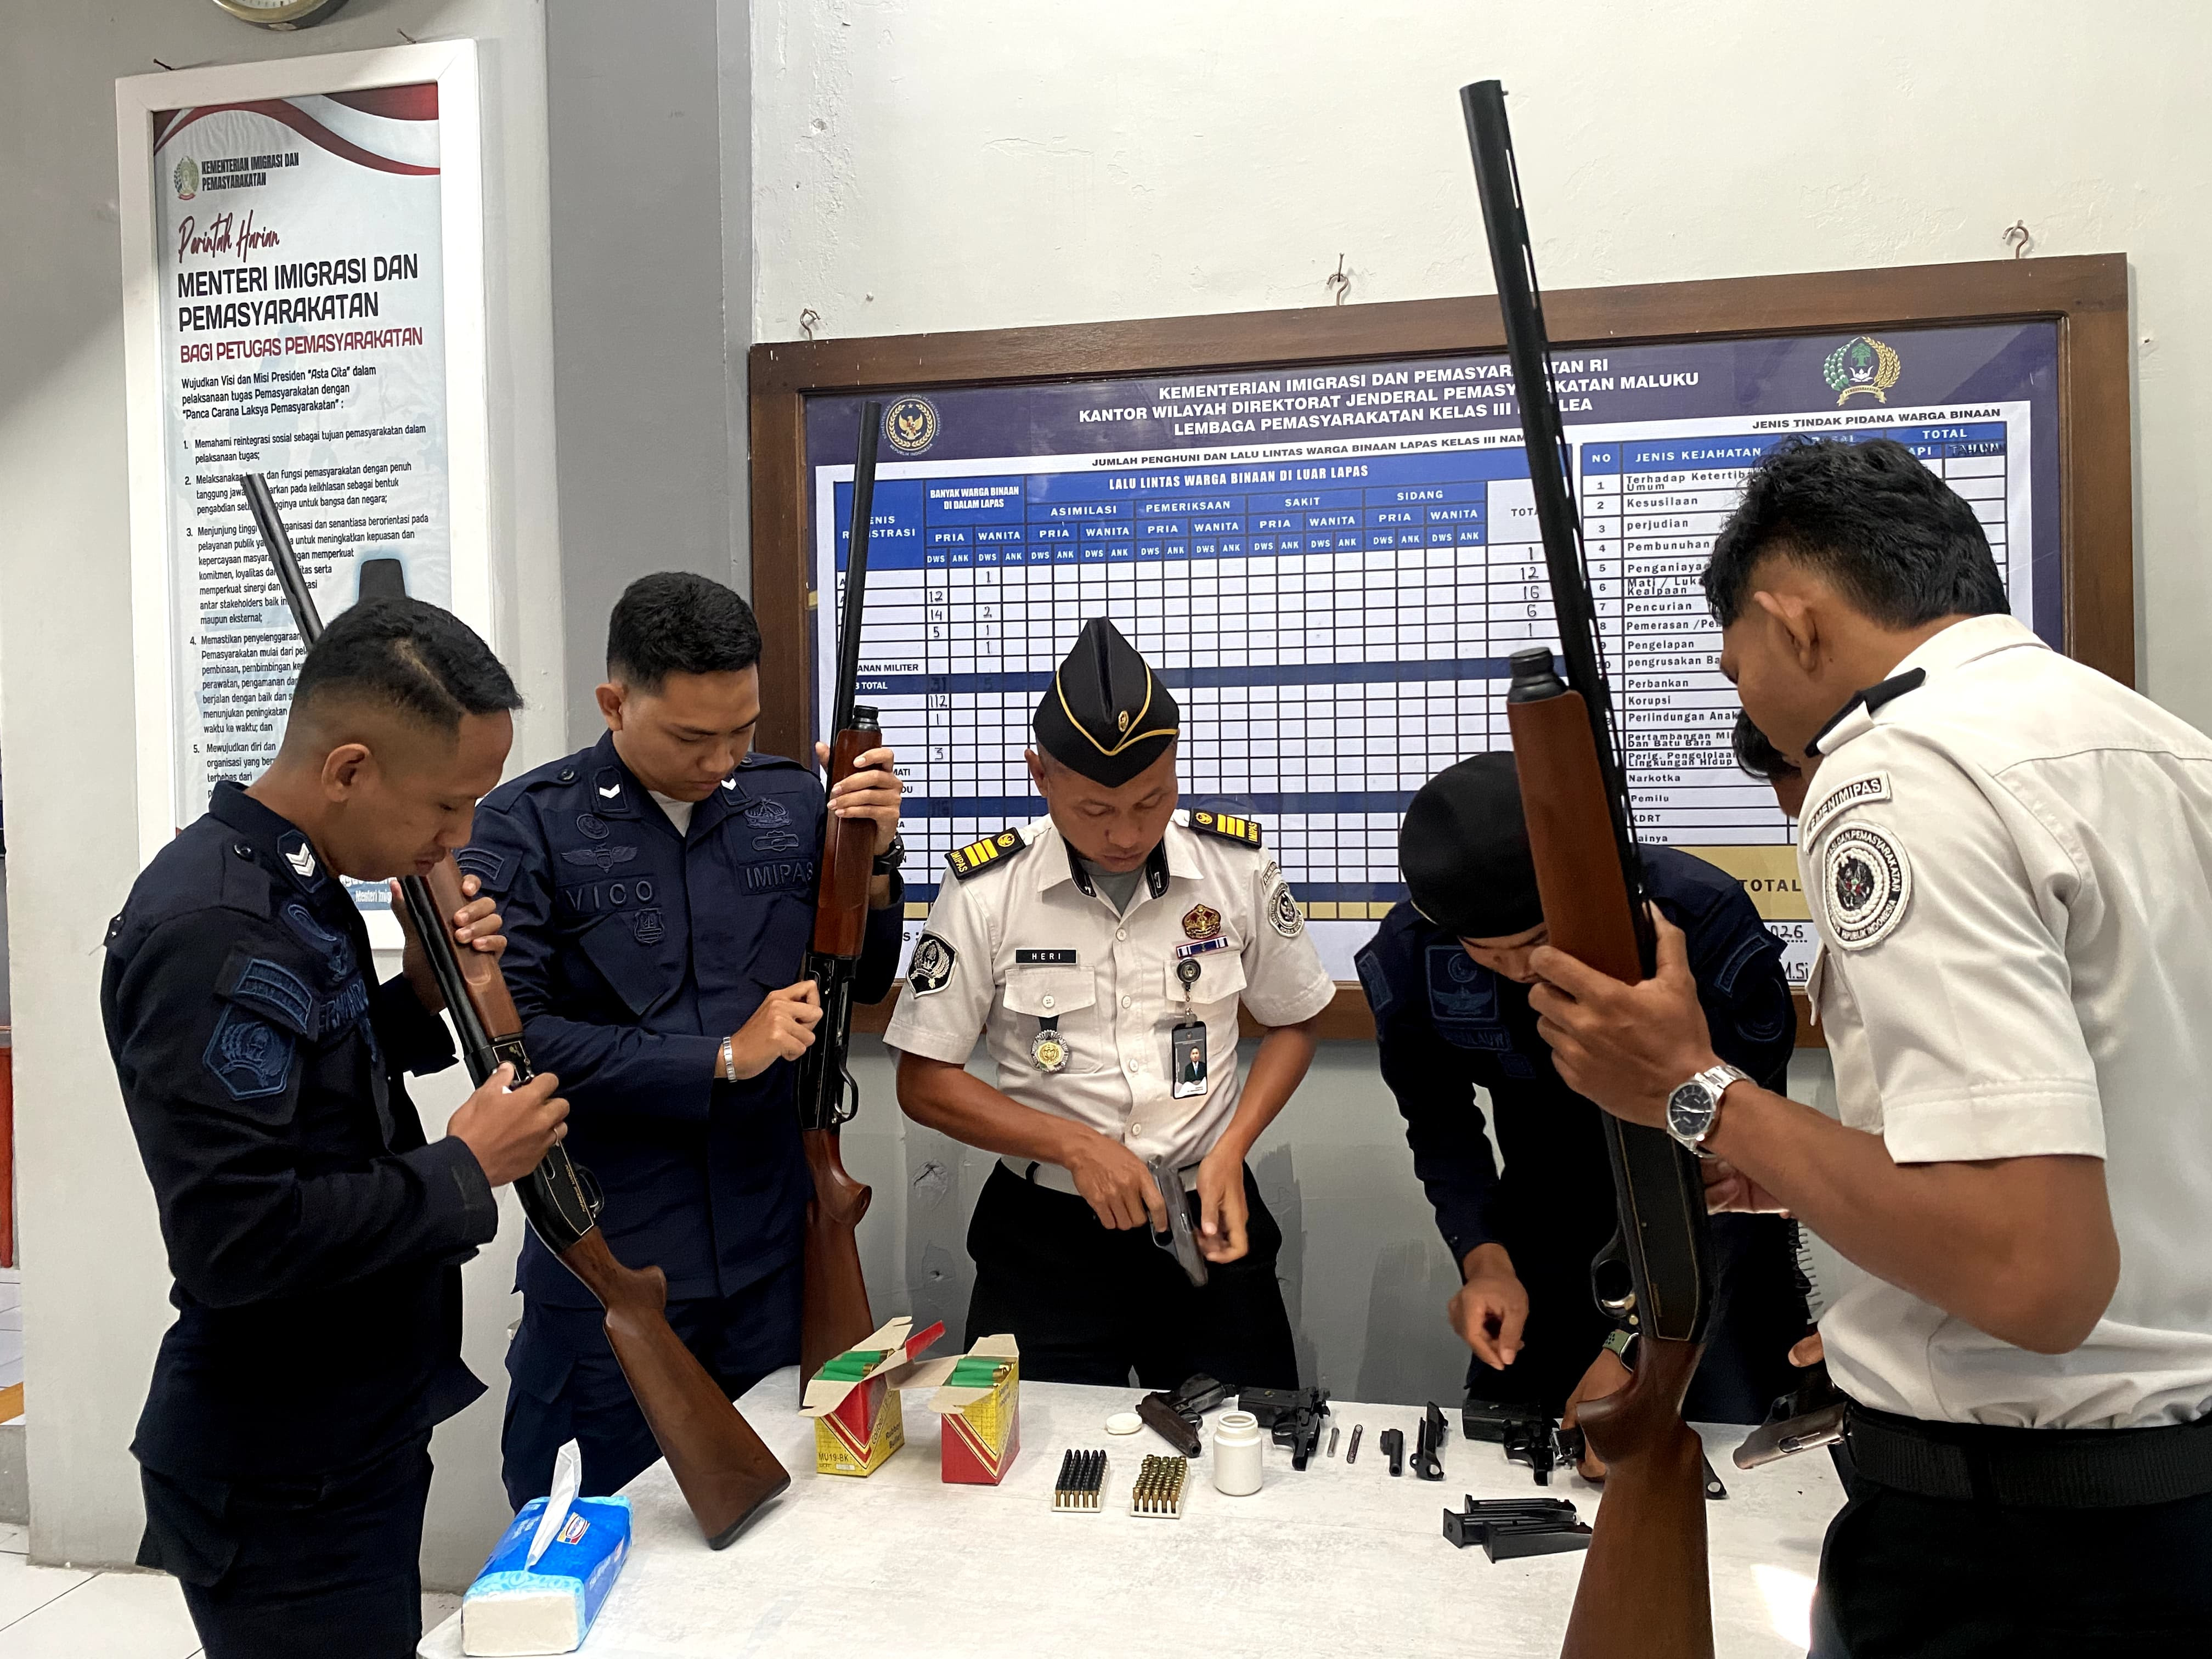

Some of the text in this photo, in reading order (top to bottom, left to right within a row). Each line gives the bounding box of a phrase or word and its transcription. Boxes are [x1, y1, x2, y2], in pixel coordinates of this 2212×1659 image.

[202, 153, 299, 174] KEMENTERIAN IMIGRASI DAN
[202, 172, 266, 191] PEMASYARAKATAN
[179, 210, 279, 263] Perintah Harian
[178, 253, 417, 297] MENTERI IMIGRASI DAN
[179, 292, 379, 331] PEMASYARAKATAN
[180, 328, 422, 363] BAGI PETUGAS PEMASYARAKATAN
[182, 377, 218, 390] Wujudkan
[221, 375, 235, 386] Visi
[238, 374, 251, 385] dan
[253, 373, 269, 382] Misi
[272, 370, 305, 382] Presiden
[353, 365, 376, 376] dalam
[1159, 359, 1607, 400] KEMENTERIAN IMIGRASI DAN PEMASYARTAN RI
[182, 383, 349, 407] pelaksanaan tugas Pemasyarakatan dengan
[1079, 408, 1147, 422] KANTOR
[1153, 403, 1226, 419] WILAYAH
[1232, 397, 1340, 414] DIREKTORAT
[1346, 389, 1438, 408] JENDERAL
[1621, 373, 1699, 390] MALUKU
[212, 407, 239, 418] Carana
[241, 404, 268, 417] Laksya
[1175, 420, 1255, 436] LEMBAGA
[1261, 408, 1423, 431] PEMASYARAKATAN
[1430, 404, 1487, 420] KELAS
[1493, 403, 1511, 416] III
[1752, 408, 2001, 430] JENIS TINDAK PIDANA WARGA BINAAN
[184, 424, 426, 449] 1. Memahami reintegrasi sosial sebagai tujuan pemasyarakatan dalam
[1923, 429, 1968, 439] TOTAL
[1092, 457, 1137, 466] JUMLAH
[1141, 454, 1200, 464] PENGHUNI
[1204, 453, 1226, 461] DAN
[1231, 451, 1259, 459] LALU
[1262, 448, 1302, 458] LINTAS
[1307, 445, 1348, 455] WARGA
[1352, 443, 1397, 452] BINAAN
[1400, 440, 1437, 450] LAPAS
[1441, 438, 1480, 447] KELAS
[1592, 453, 1611, 462] NO
[1635, 448, 1761, 462] JENIS KEJAHATAN
[195, 451, 259, 465] pelaksanaan tugas;
[1109, 465, 1369, 490] LALU LINTAS WARGA BINAAN DI LUAR LAPAS
[1627, 475, 1685, 483] Terhadap
[930, 486, 1019, 499] BANYAK WARGA BINAAN
[1397, 490, 1443, 501] SIDANG
[944, 499, 1004, 510] DI DALAM LAPAS
[1146, 501, 1231, 512] PEMERIKSAAN
[1285, 497, 1320, 507] SAKIT
[1627, 497, 1698, 507] Kesusilaan
[1051, 506, 1117, 516] ASIMILASI
[1430, 510, 1478, 520] WANITA
[1309, 516, 1355, 527] WANITA
[1379, 513, 1411, 523] PRIA
[187, 523, 257, 537] 3. Menjunjung tinggi
[1148, 525, 1178, 534] PRIA
[1194, 522, 1239, 532] WANITA
[1260, 520, 1290, 529] PRIA
[1627, 518, 1688, 531] perjudian
[978, 532, 1020, 541] WANITA
[1040, 529, 1069, 538] PRIA
[1086, 527, 1129, 537] WANITA
[935, 533, 965, 543] PRIA
[1628, 540, 1709, 551] Pembunuhan
[952, 554, 969, 562] ANK
[1520, 567, 1539, 580] 12
[929, 591, 943, 602] 12
[1523, 586, 1539, 600] 16
[1627, 602, 1691, 612] Pencurian
[930, 611, 943, 621] 14
[1627, 620, 1688, 630] Pemerasan
[190, 636, 196, 645] 4.
[201, 634, 241, 645] Memastikan
[1628, 640, 1694, 651] Pengelapan
[202, 647, 293, 661] Pemasyarakatan mulai dari
[1628, 657, 1701, 669] pengrusakan
[1628, 679, 1689, 689] Perbankan
[930, 695, 947, 708] 112
[1628, 696, 1671, 706] Korupsi
[1628, 712, 1738, 722] Perlindungan Anak
[193, 742, 276, 754] 5. Mewujudkan diri dan
[950, 851, 968, 873] IMIPAS
[567, 881, 653, 911] VICO
